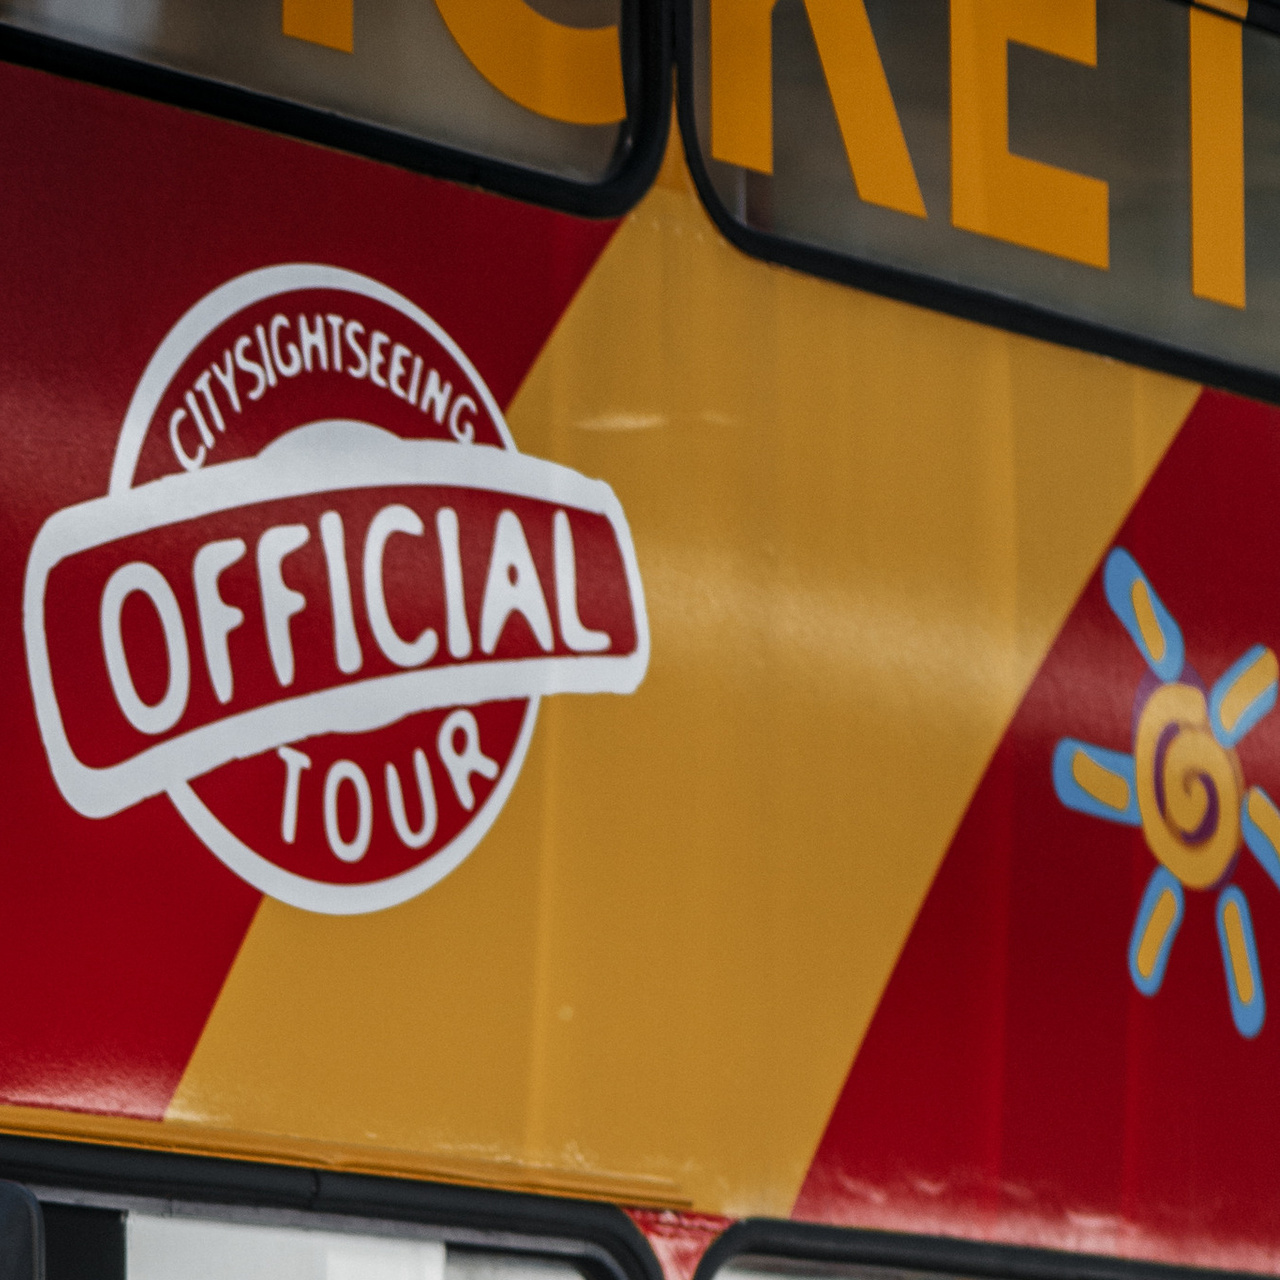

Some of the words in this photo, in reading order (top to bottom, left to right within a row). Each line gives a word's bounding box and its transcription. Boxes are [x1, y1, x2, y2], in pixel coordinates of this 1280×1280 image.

[168, 314, 478, 472] CITYSIGHTSEEING
[100, 504, 611, 734] OFFICIAL
[278, 709, 499, 863] TOUR
